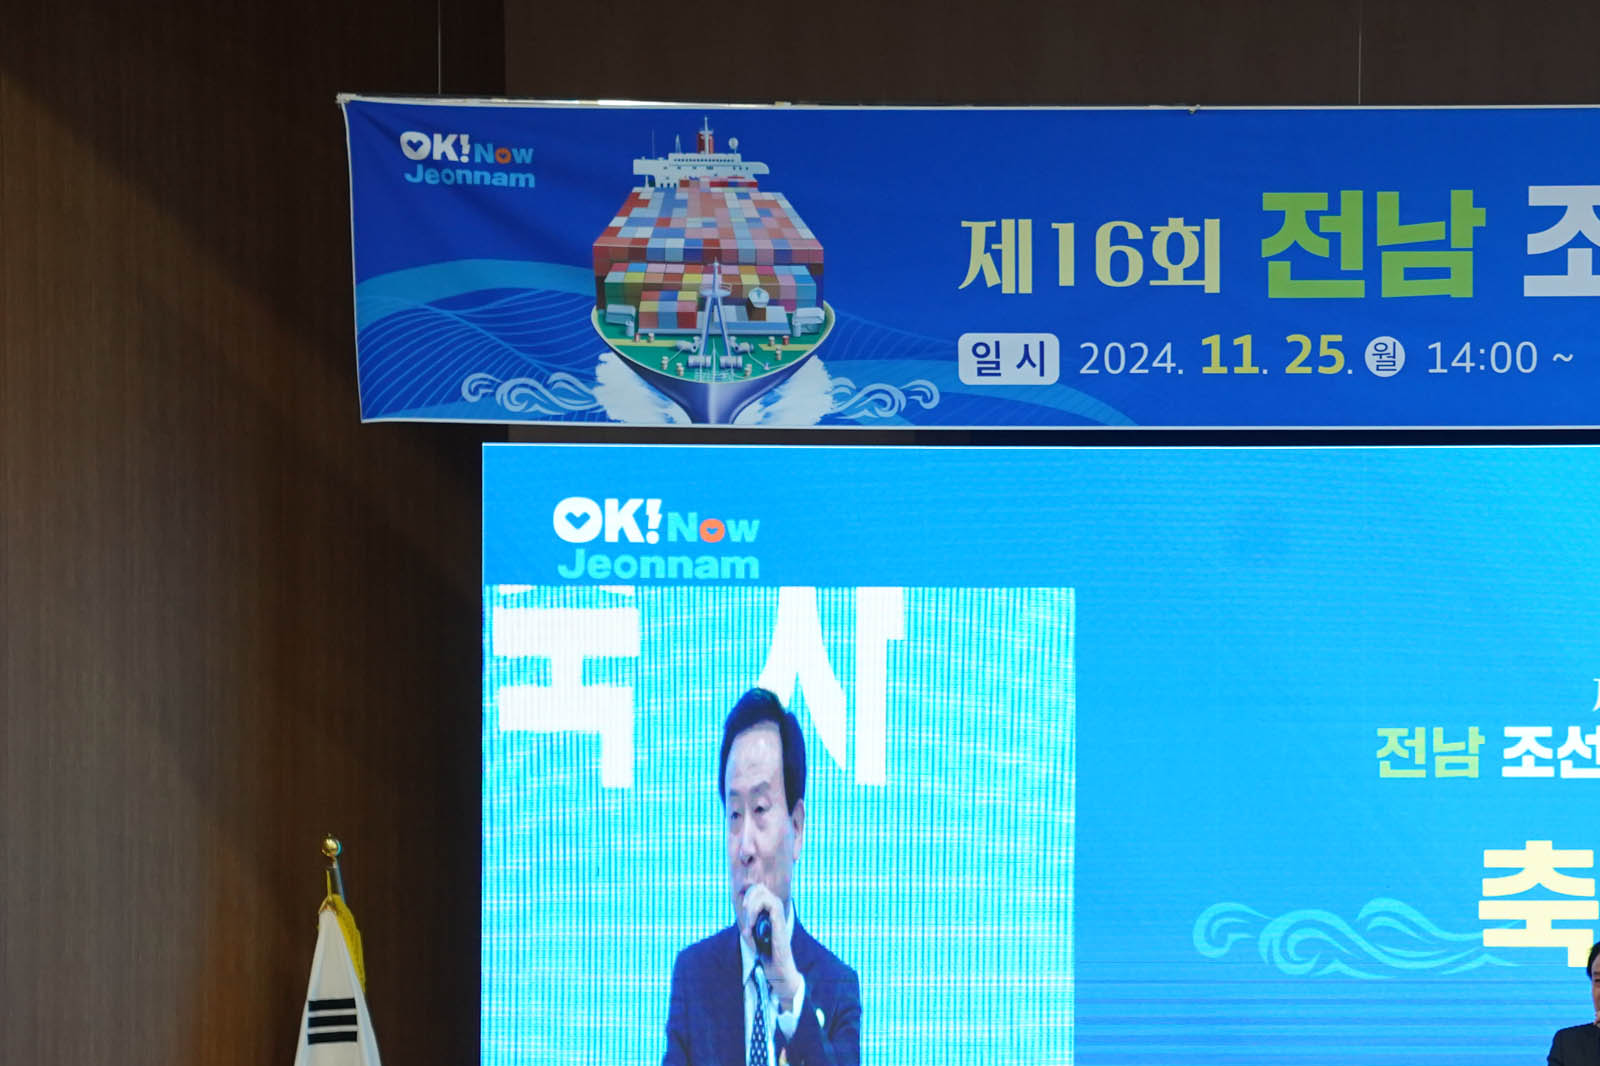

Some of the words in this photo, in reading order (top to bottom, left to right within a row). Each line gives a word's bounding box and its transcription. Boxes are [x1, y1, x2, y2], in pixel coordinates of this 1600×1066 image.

[400, 131, 470, 163] OK!
[474, 143, 533, 164] Now
[404, 164, 535, 188] Jeonnam
[957, 217, 1221, 294] 제16회
[1260, 190, 1486, 299] 전남
[1079, 342, 1184, 377] 2024.
[1200, 334, 1268, 375] 11.
[1285, 334, 1354, 375] 25.
[1371, 339, 1401, 374] 월
[1427, 341, 1538, 374] 14:00
[553, 497, 662, 544] OK!
[667, 512, 760, 543] Now
[557, 548, 759, 579] Jeonnam
[1376, 726, 1485, 778] 전남
